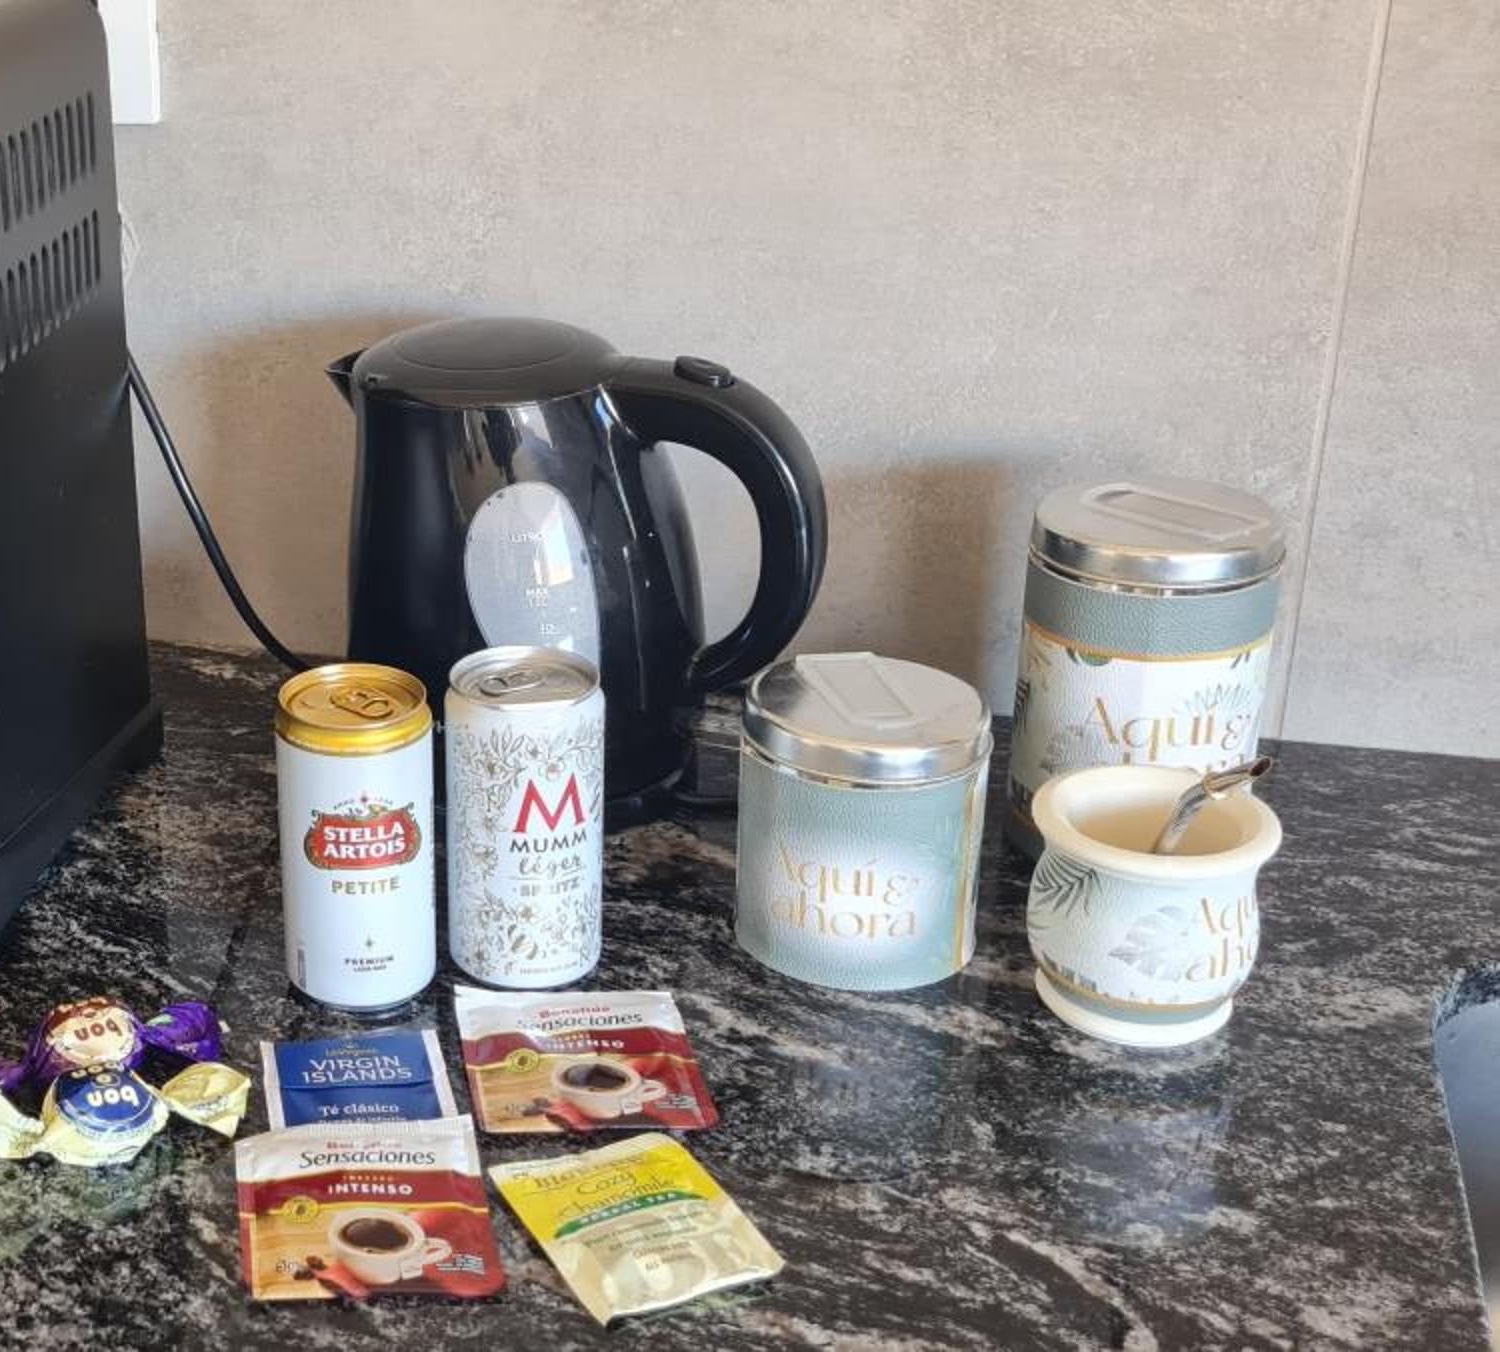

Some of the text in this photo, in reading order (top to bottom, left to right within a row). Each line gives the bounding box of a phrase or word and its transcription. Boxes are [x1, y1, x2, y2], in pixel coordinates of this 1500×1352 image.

[323, 821, 404, 843] STELLA
[509, 829, 587, 853] MUMM
[323, 838, 405, 859] ARTOIS
[331, 876, 401, 895] PETITE
[520, 876, 581, 897] SPITZ
[770, 890, 917, 940] ahora
[309, 1055, 400, 1071] VIRGIN
[302, 1067, 413, 1084] ISLANDS
[300, 1149, 437, 1169] Sensaciones
[327, 1183, 414, 1196] INTENSO
